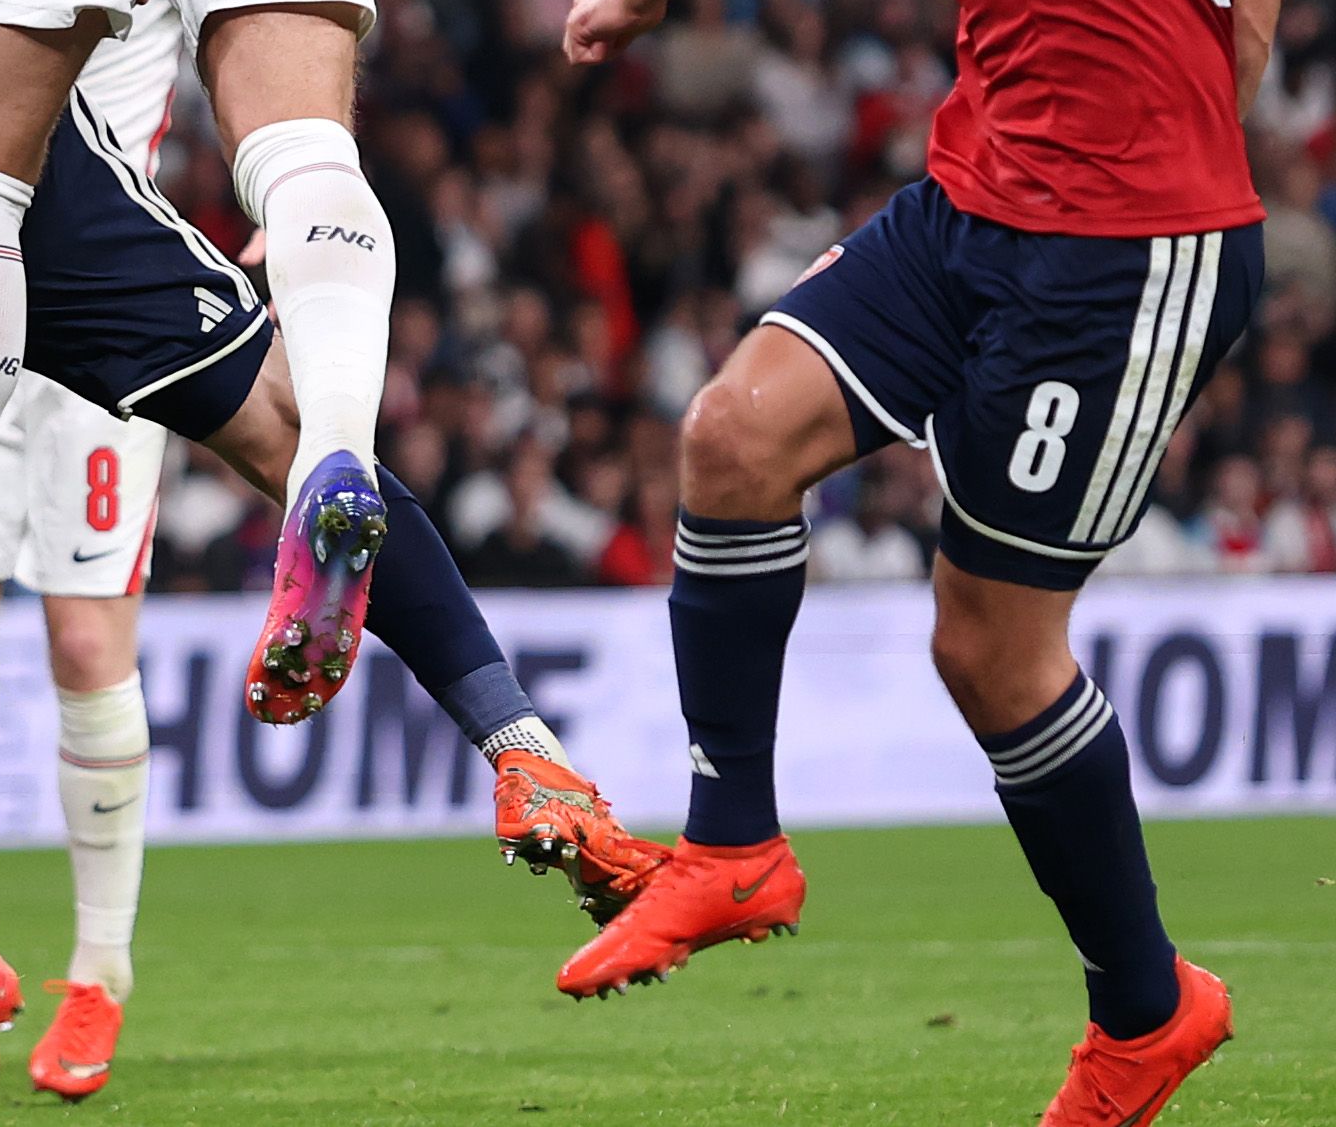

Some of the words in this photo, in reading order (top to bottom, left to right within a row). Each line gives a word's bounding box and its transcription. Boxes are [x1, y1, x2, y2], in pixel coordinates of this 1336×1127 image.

[306, 225, 377, 253] ENG
[1007, 381, 1081, 493] 8
[86, 446, 119, 532] 8
